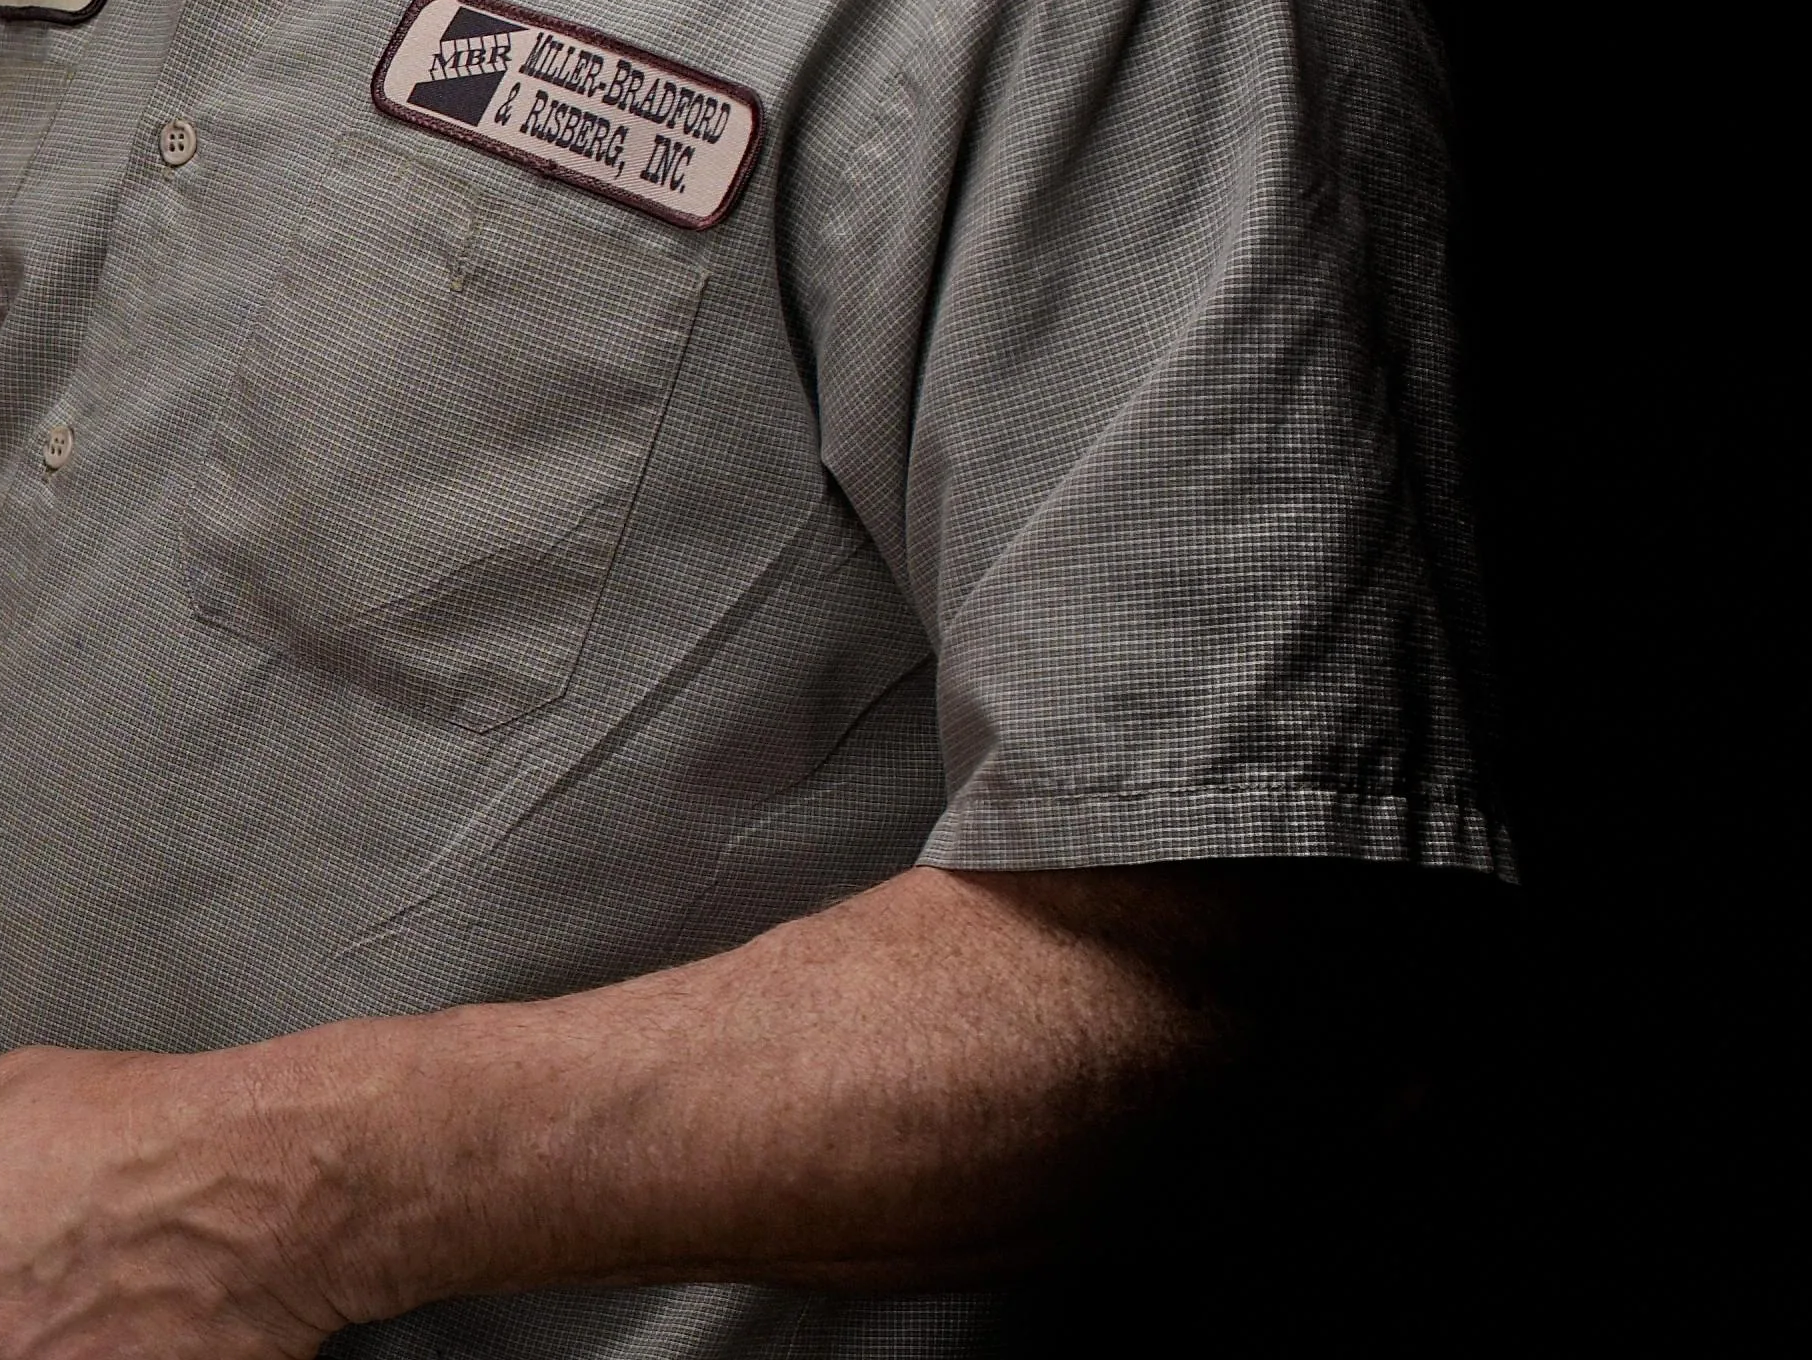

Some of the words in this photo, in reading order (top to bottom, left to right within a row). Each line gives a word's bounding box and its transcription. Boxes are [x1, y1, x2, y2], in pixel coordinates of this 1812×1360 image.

[430, 44, 512, 72] MBR
[519, 32, 731, 145] MILLER-BRADFORD
[495, 82, 522, 126] &
[520, 90, 630, 178] RISBERG,
[640, 134, 695, 194] INC.
